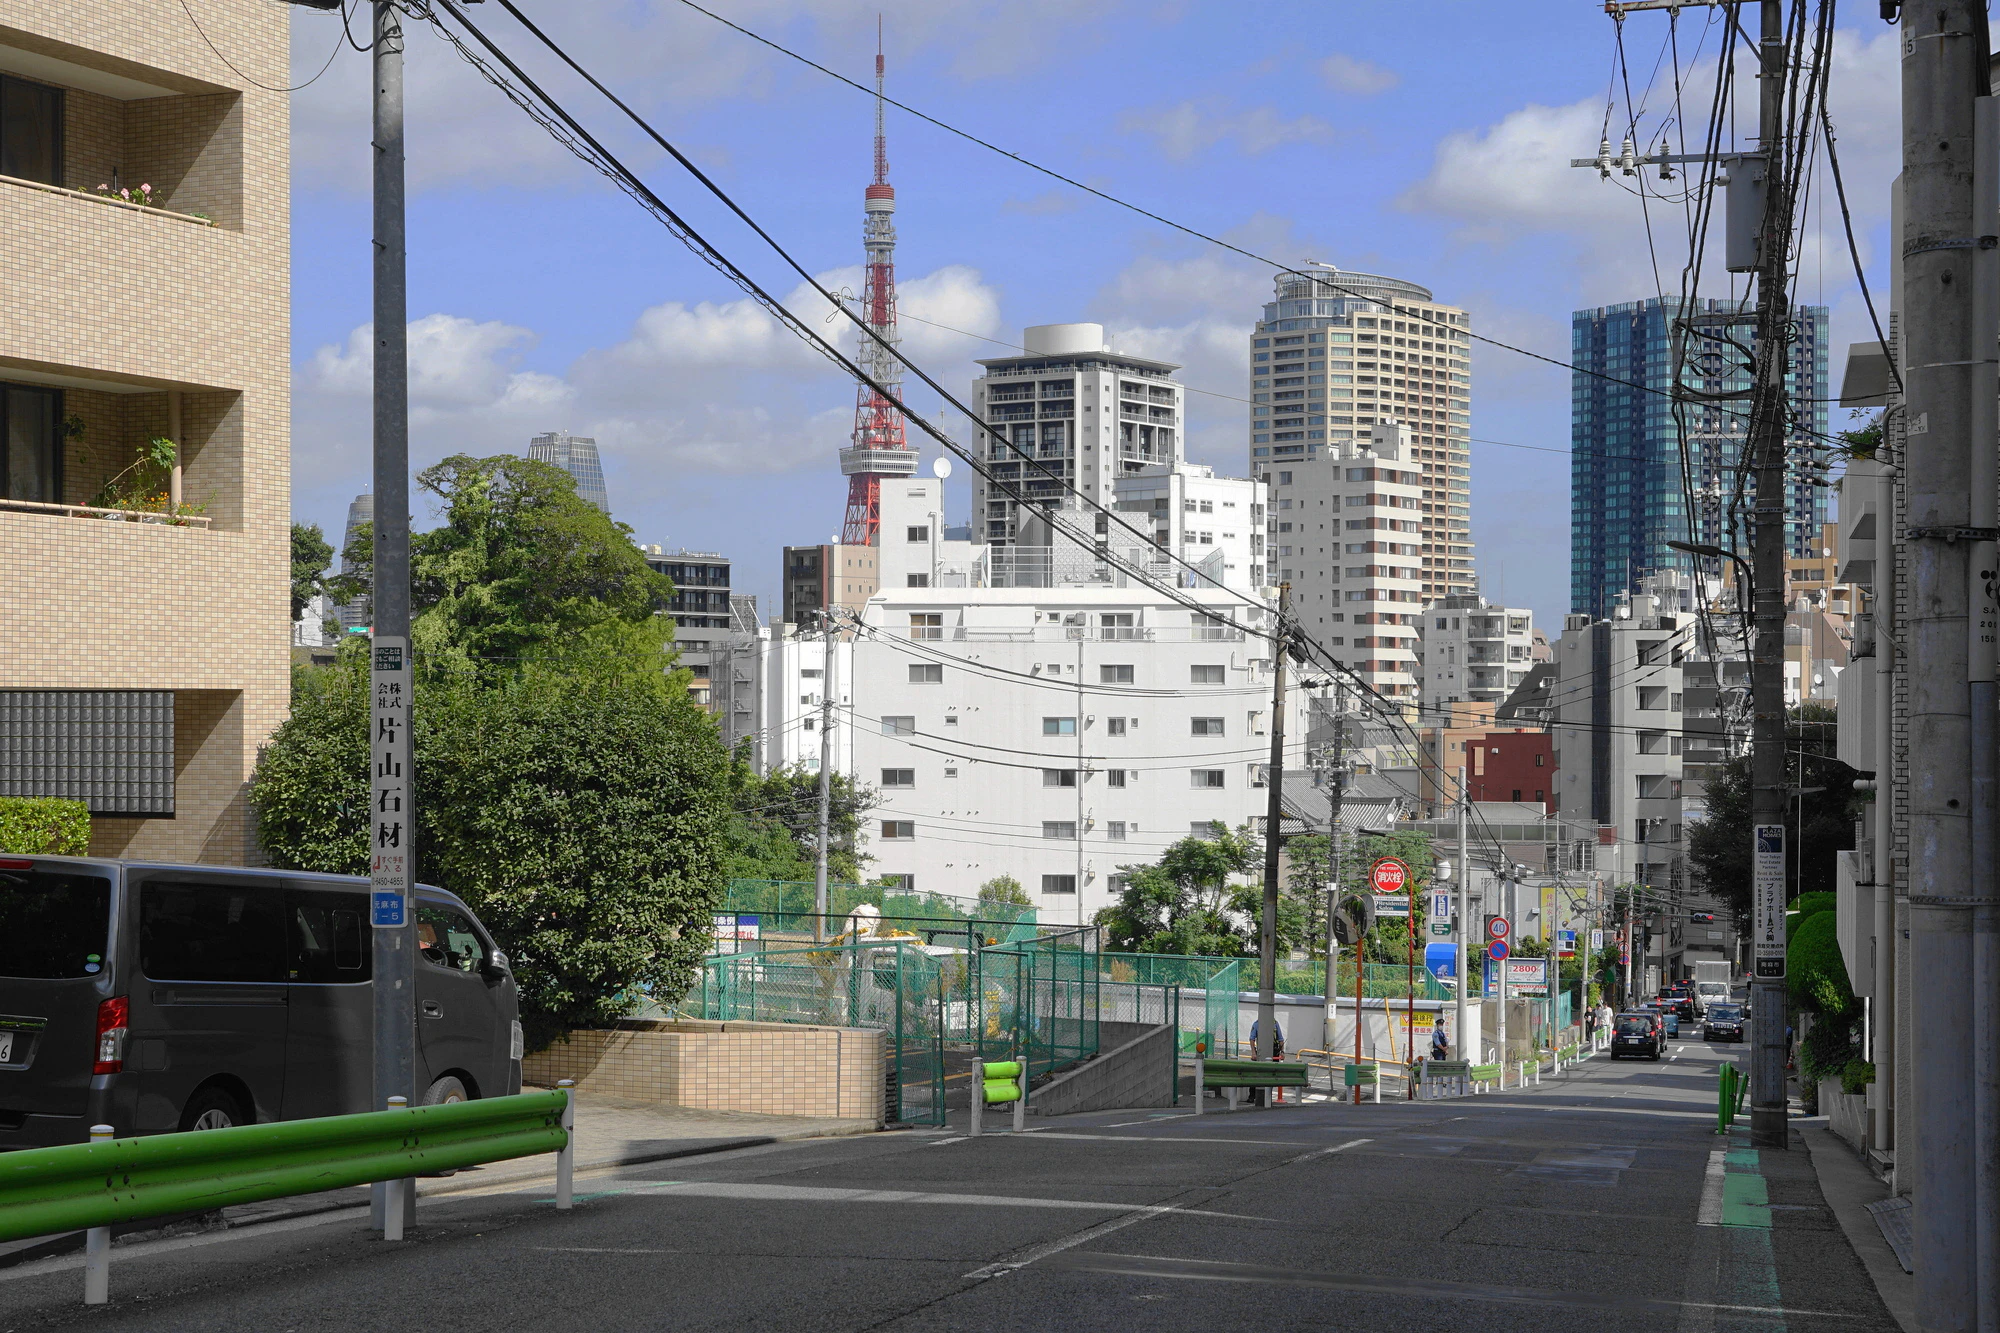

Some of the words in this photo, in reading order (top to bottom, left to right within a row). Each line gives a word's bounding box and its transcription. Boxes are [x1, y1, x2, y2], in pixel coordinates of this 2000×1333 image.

[377, 717, 402, 848] 片山石材
[381, 856, 403, 864] すぐ手前
[1377, 871, 1402, 883] 消火栓
[375, 900, 399, 909] 元麻布
[1493, 923, 1506, 933] 40
